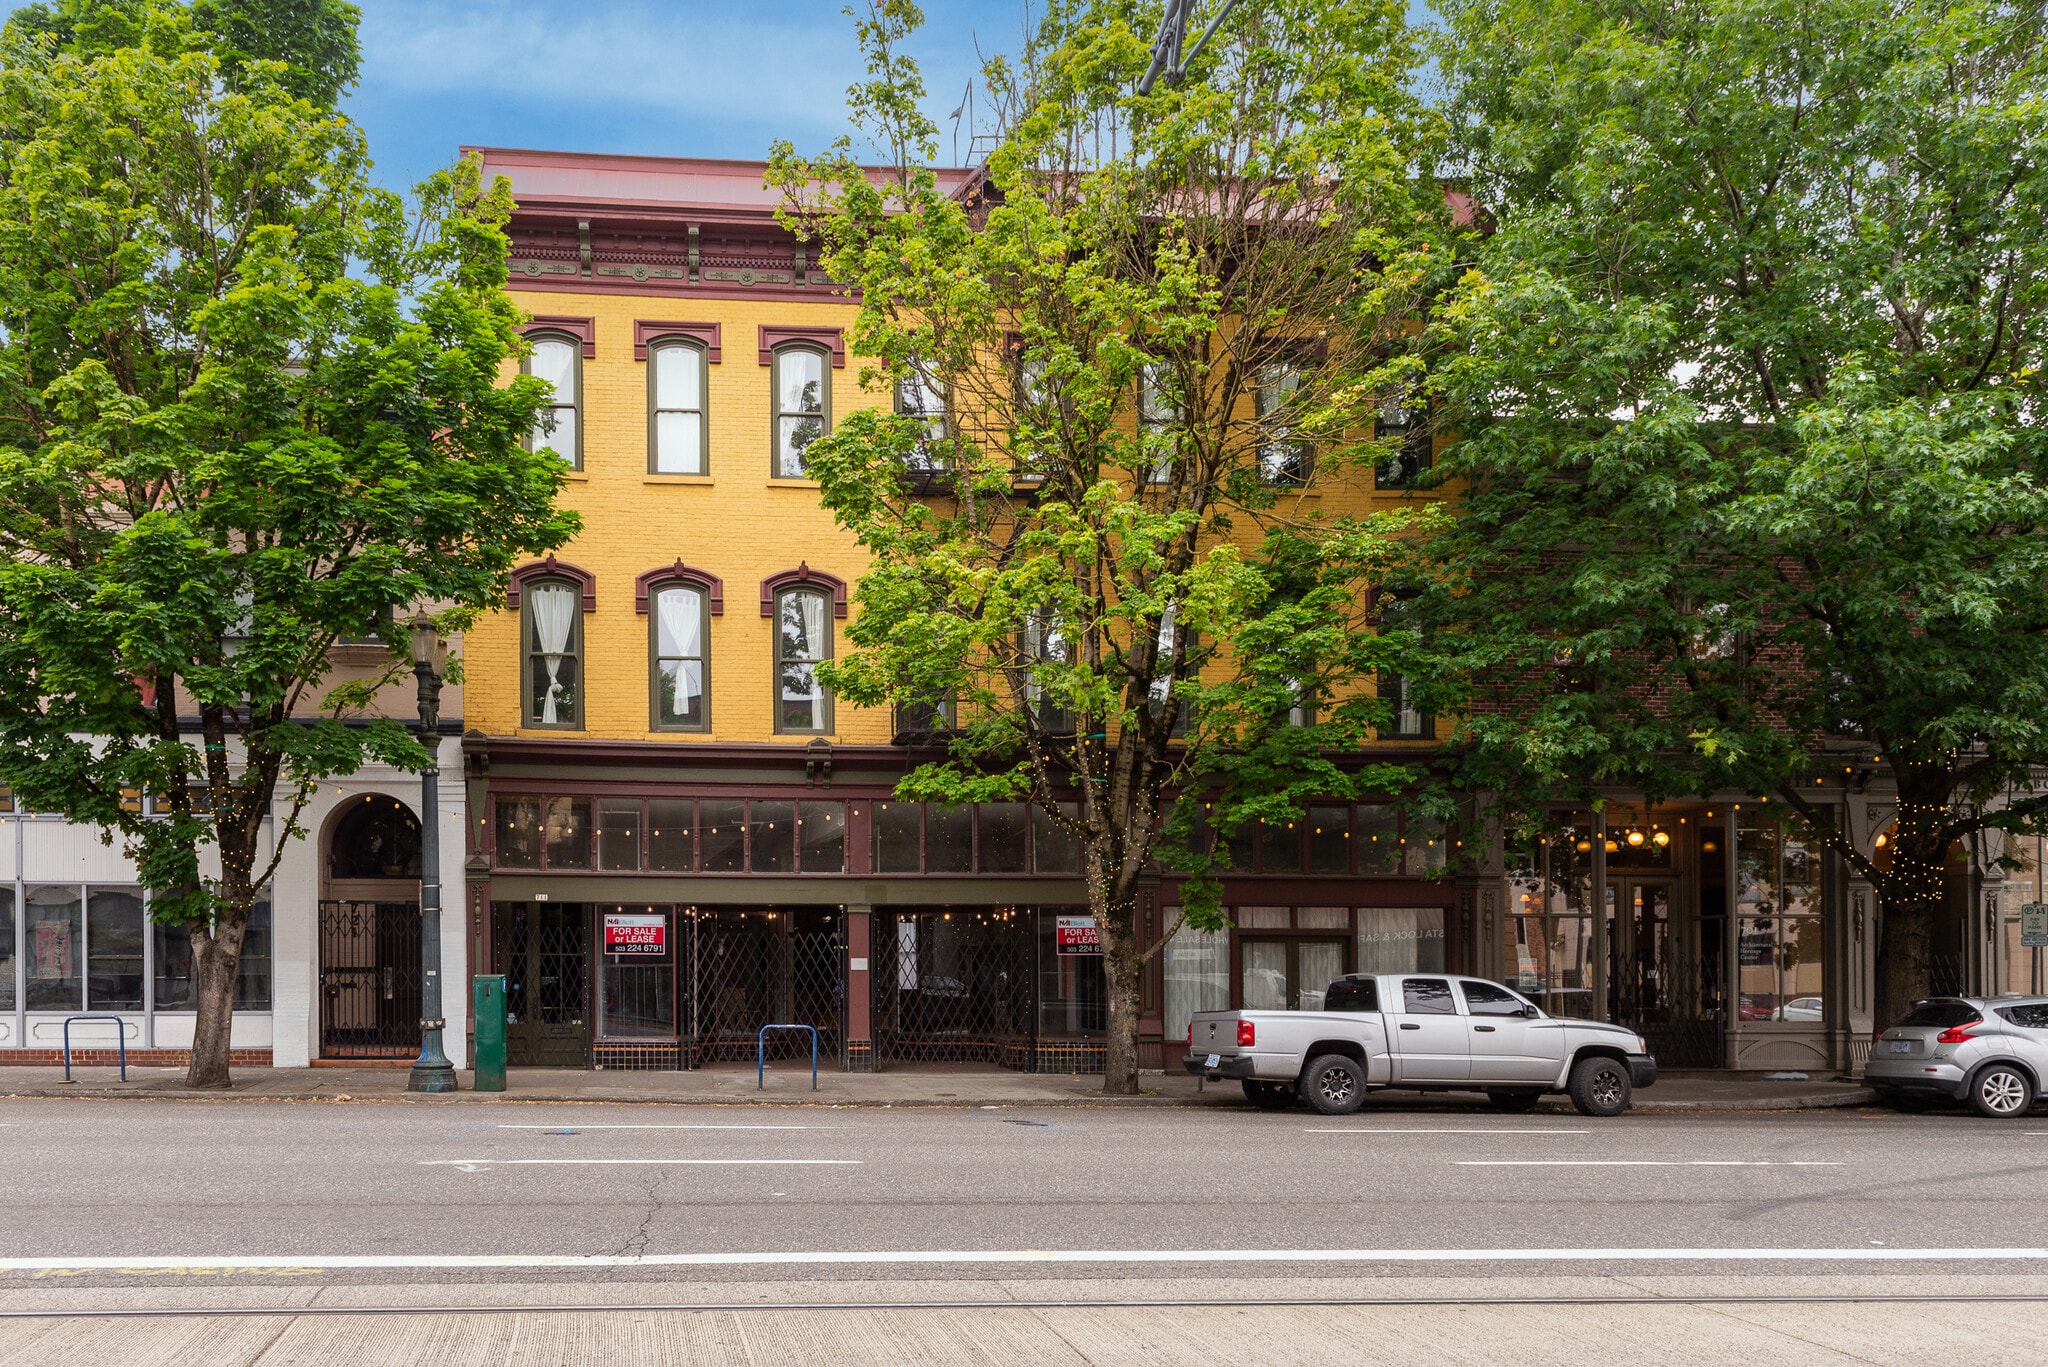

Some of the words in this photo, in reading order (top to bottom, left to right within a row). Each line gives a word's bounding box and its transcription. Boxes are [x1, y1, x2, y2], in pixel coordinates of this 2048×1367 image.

[613, 927, 631, 935] FOR
[634, 927, 656, 936] SALE
[1064, 928, 1082, 936] FOR
[1084, 928, 1097, 936] SA
[1741, 926, 1757, 936] 701
[626, 935, 655, 943] LEASE
[1077, 936, 1100, 944] LEAS
[627, 944, 642, 952] 224
[643, 944, 663, 952] 6791
[1740, 948, 1762, 956] Heritage
